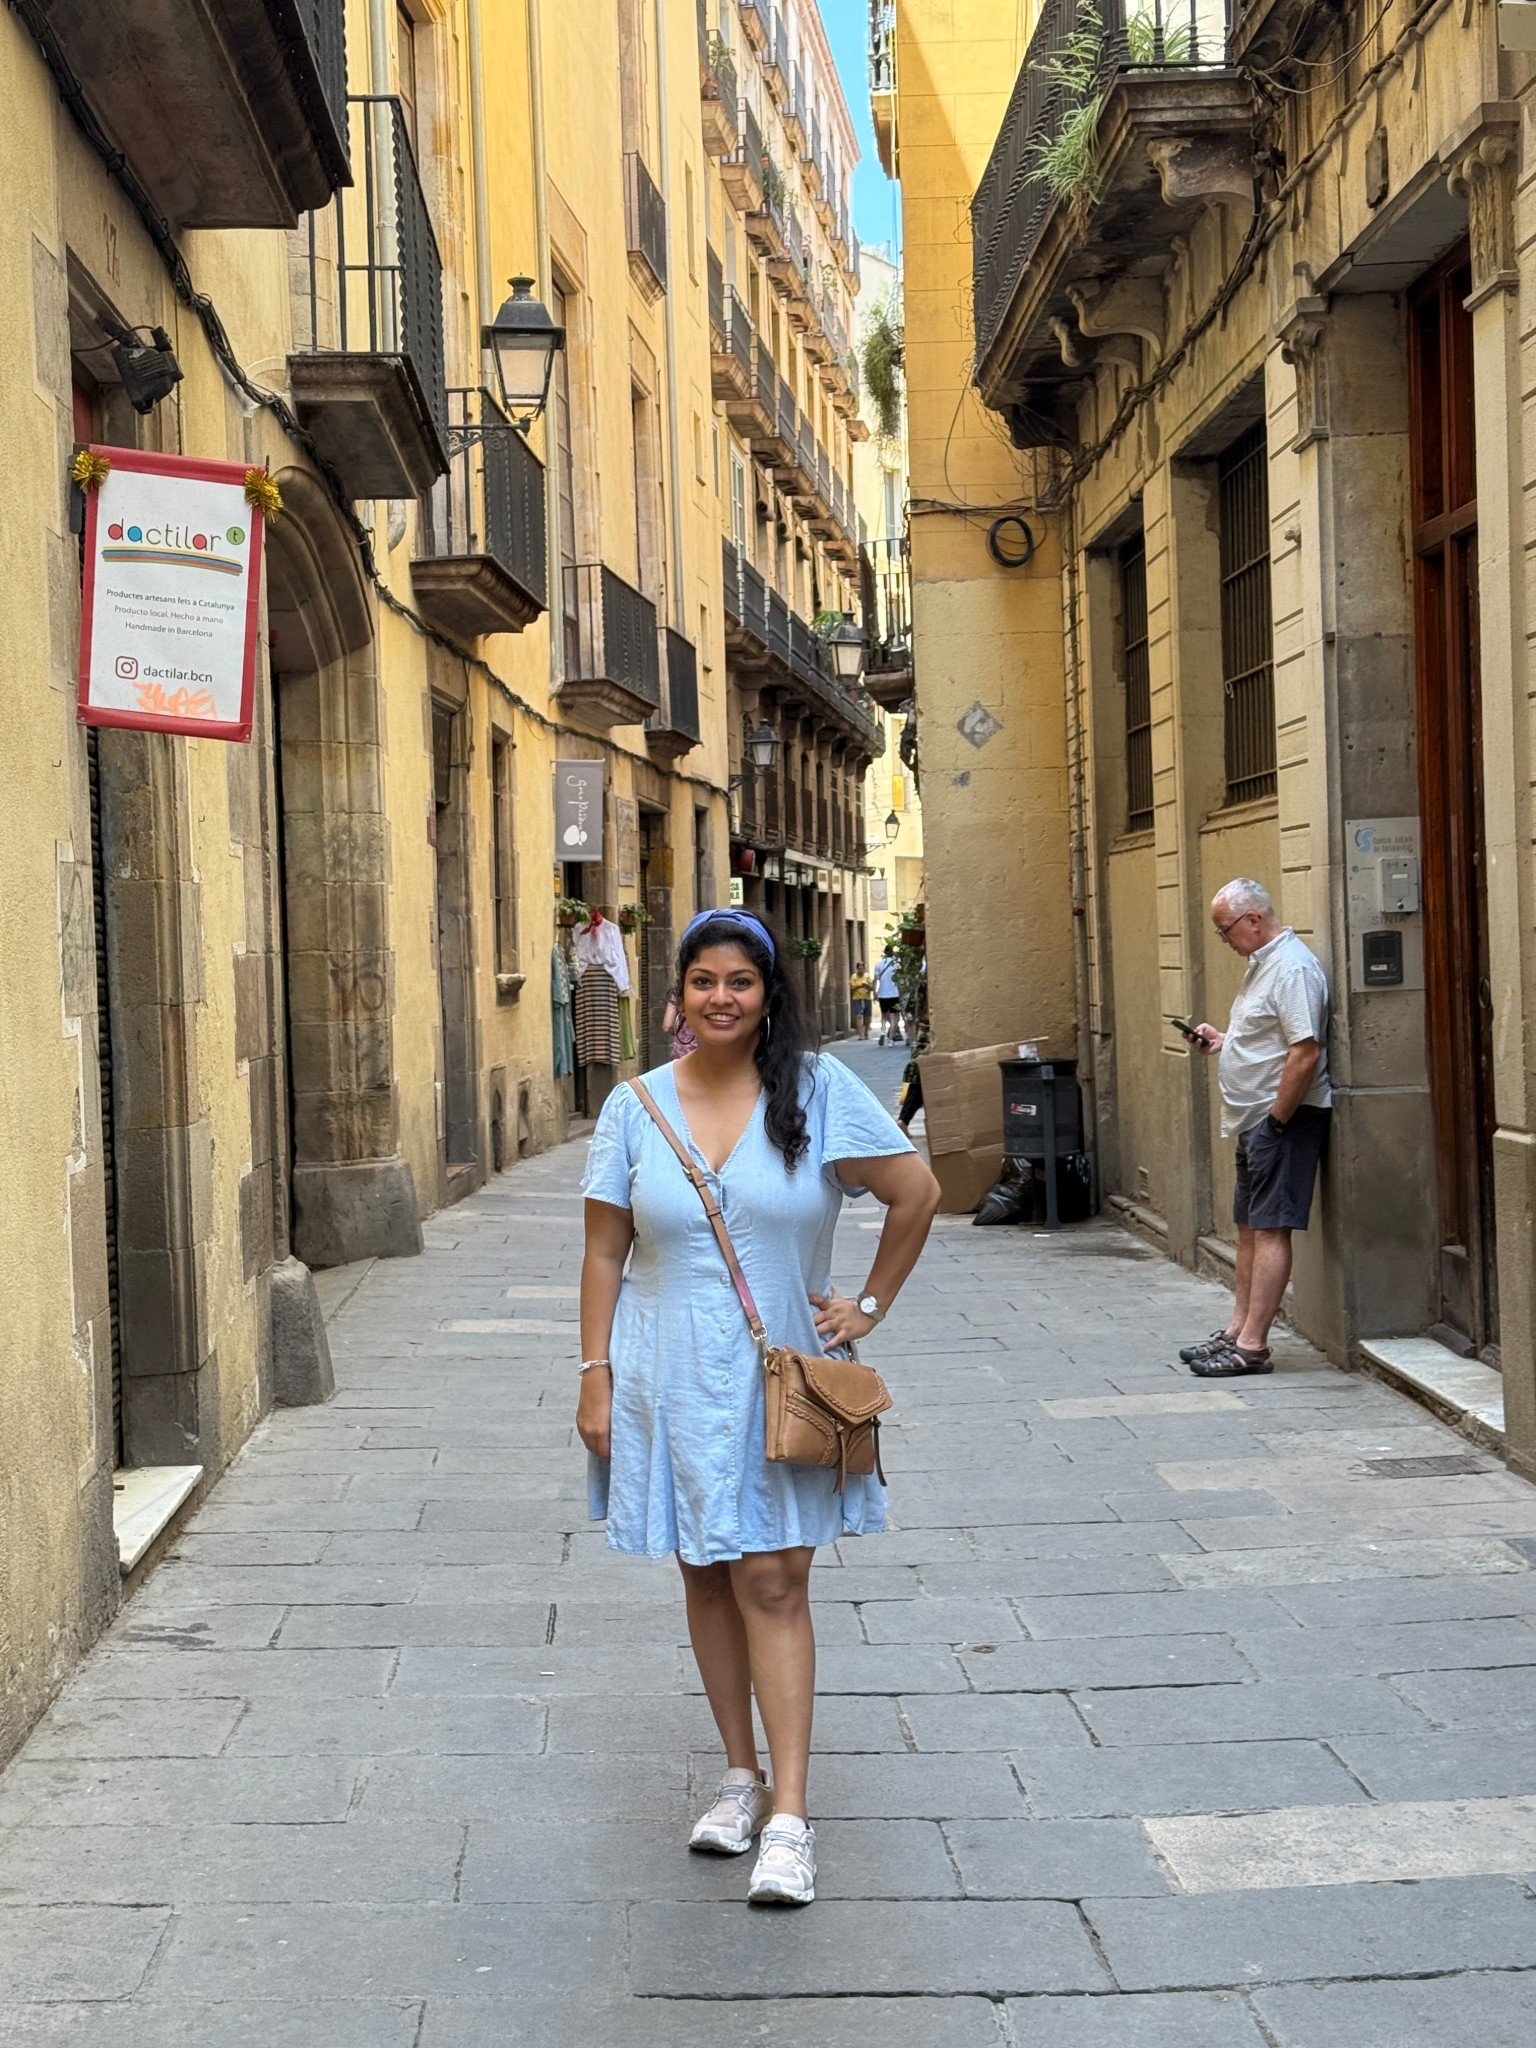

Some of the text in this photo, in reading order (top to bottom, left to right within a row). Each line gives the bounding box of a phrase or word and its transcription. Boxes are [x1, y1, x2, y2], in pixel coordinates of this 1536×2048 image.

[106, 588, 143, 600] Productes
[144, 593, 176, 604] artesans
[177, 596, 191, 606] fets
[198, 599, 235, 611] Catalunya
[114, 605, 149, 616] Producto
[170, 611, 195, 622] Hecho
[202, 616, 224, 624] mano
[125, 621, 213, 638] Handmade in Barcelona
[143, 665, 213, 683] dactilar.bcn
